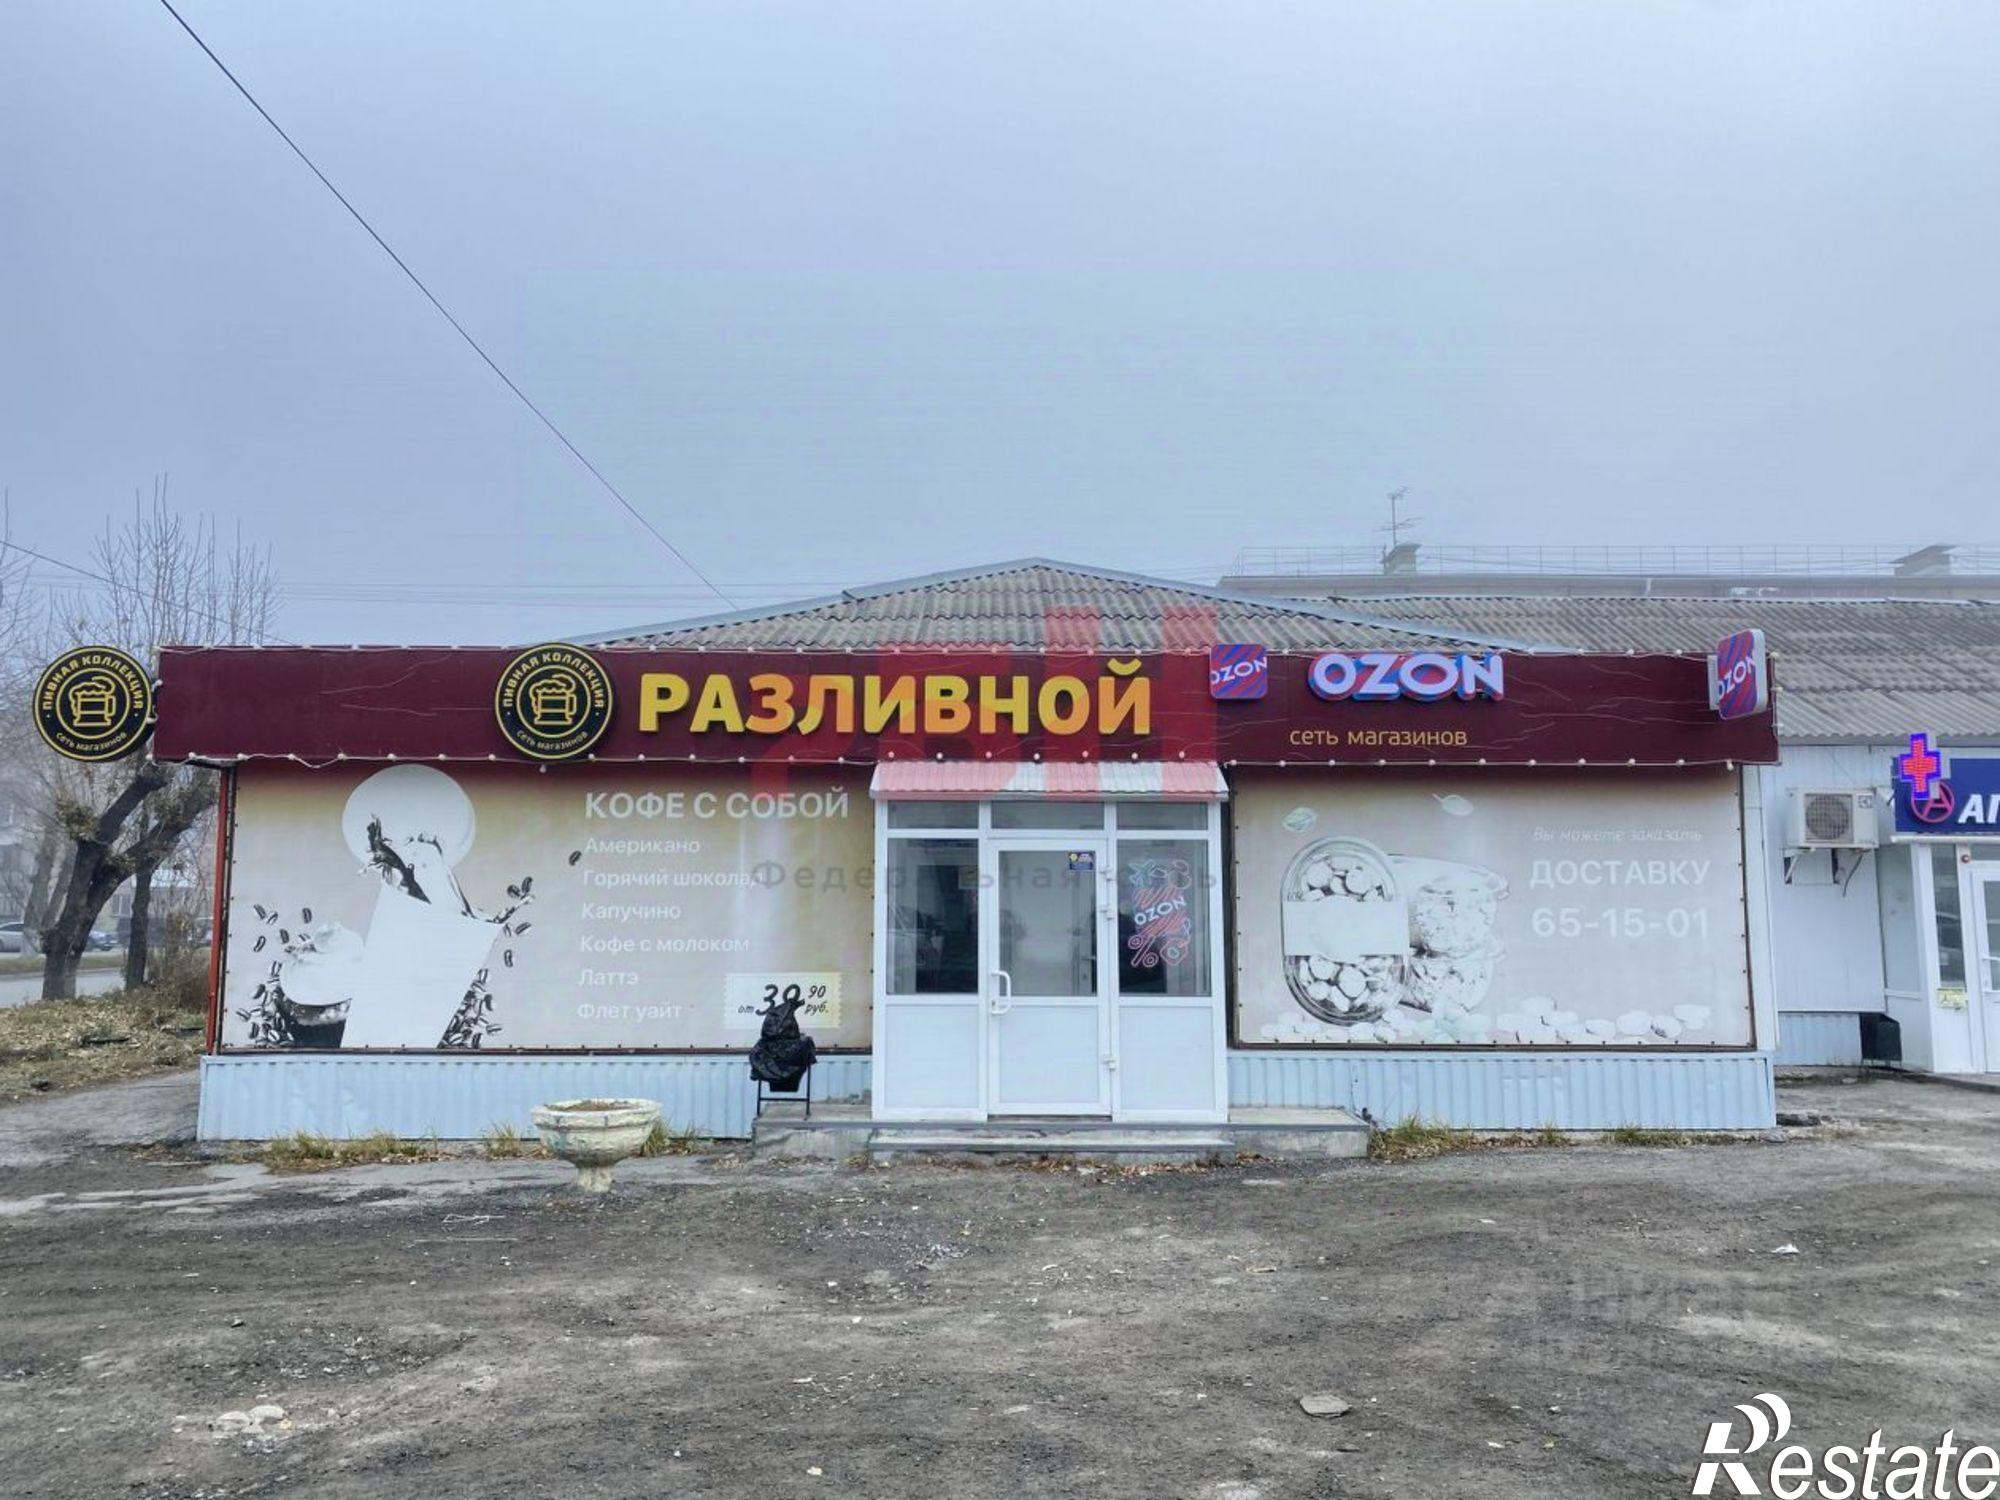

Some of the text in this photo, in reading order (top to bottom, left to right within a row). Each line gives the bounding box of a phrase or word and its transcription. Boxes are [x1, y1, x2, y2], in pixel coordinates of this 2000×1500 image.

[42, 655, 144, 711] ПИВНАЯ КОЛЛЕКЦИЯ
[502, 651, 604, 708] ПИВНАЯ КОЛЛЕКЦИЯ
[1310, 652, 1505, 700] OZON
[639, 658, 1152, 736] РАЗЛИВНОЙ
[1289, 730, 1468, 747] сеть магазинов
[584, 785, 850, 820] КОФЕ С СОБОЙ
[584, 838, 701, 857] Американо
[583, 869, 669, 890] Горячий
[1529, 859, 1712, 889] ДОСТАВКУ
[580, 902, 683, 923] Капучино
[1133, 895, 1187, 926] OZON
[1530, 906, 1709, 939] 65-15-01
[579, 936, 750, 955] Кофе с молоком
[577, 968, 640, 987] Латтэ
[808, 984, 827, 999] 90
[576, 1002, 631, 1019] Флет
[804, 1001, 829, 1017] руб.
